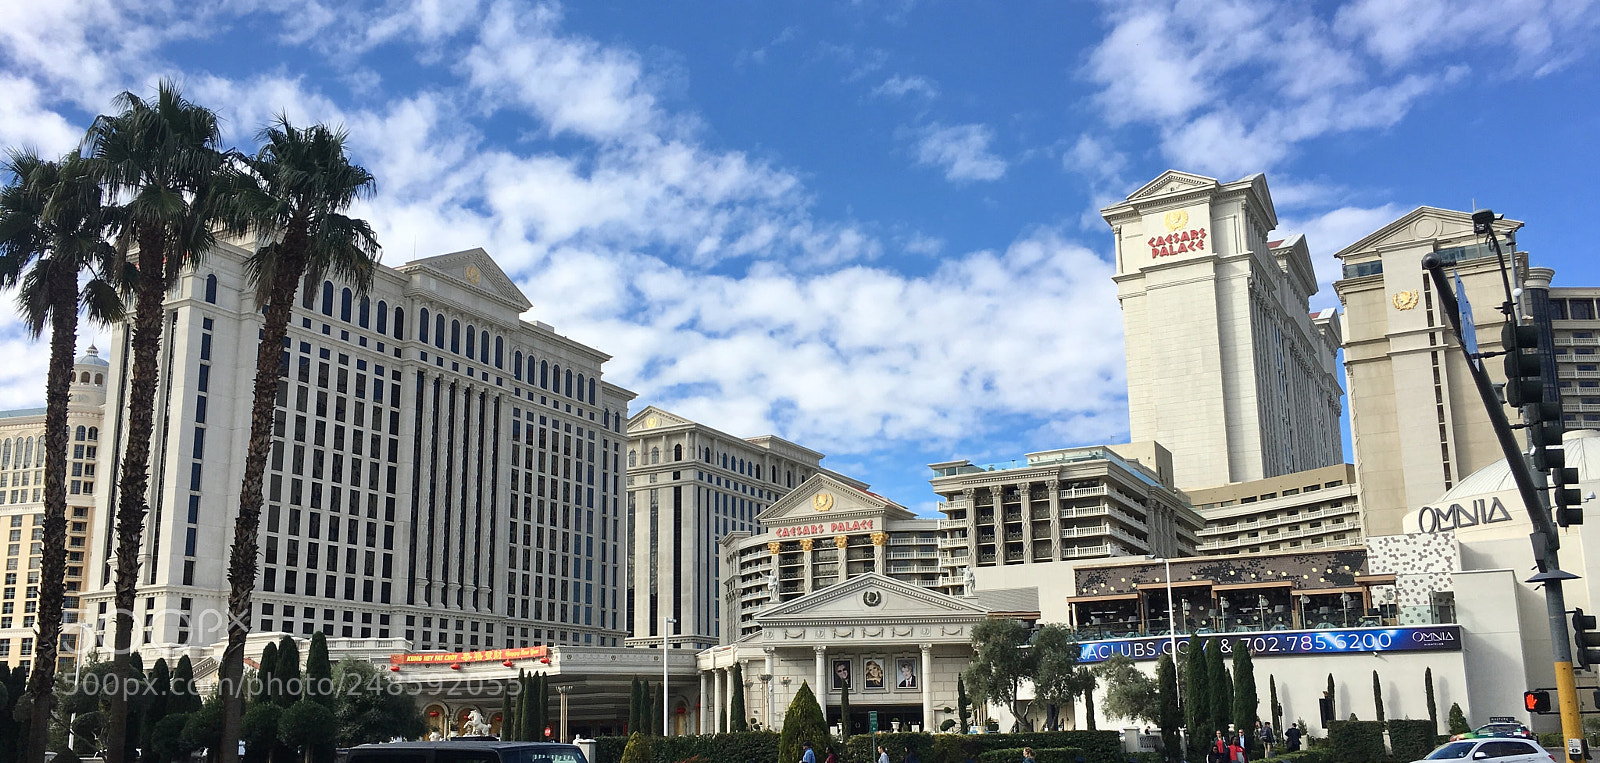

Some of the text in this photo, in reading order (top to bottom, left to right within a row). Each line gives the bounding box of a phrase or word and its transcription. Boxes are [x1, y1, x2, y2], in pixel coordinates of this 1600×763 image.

[1148, 228, 1207, 248] CAESARS
[1152, 239, 1204, 259] PALACE
[1418, 497, 1513, 533] OMNIA
[776, 519, 873, 538] CAESARS PALACE
[1220, 638, 1233, 653] &
[1240, 632, 1392, 652] 702.785.6200
[1412, 631, 1455, 643] OMNIA
